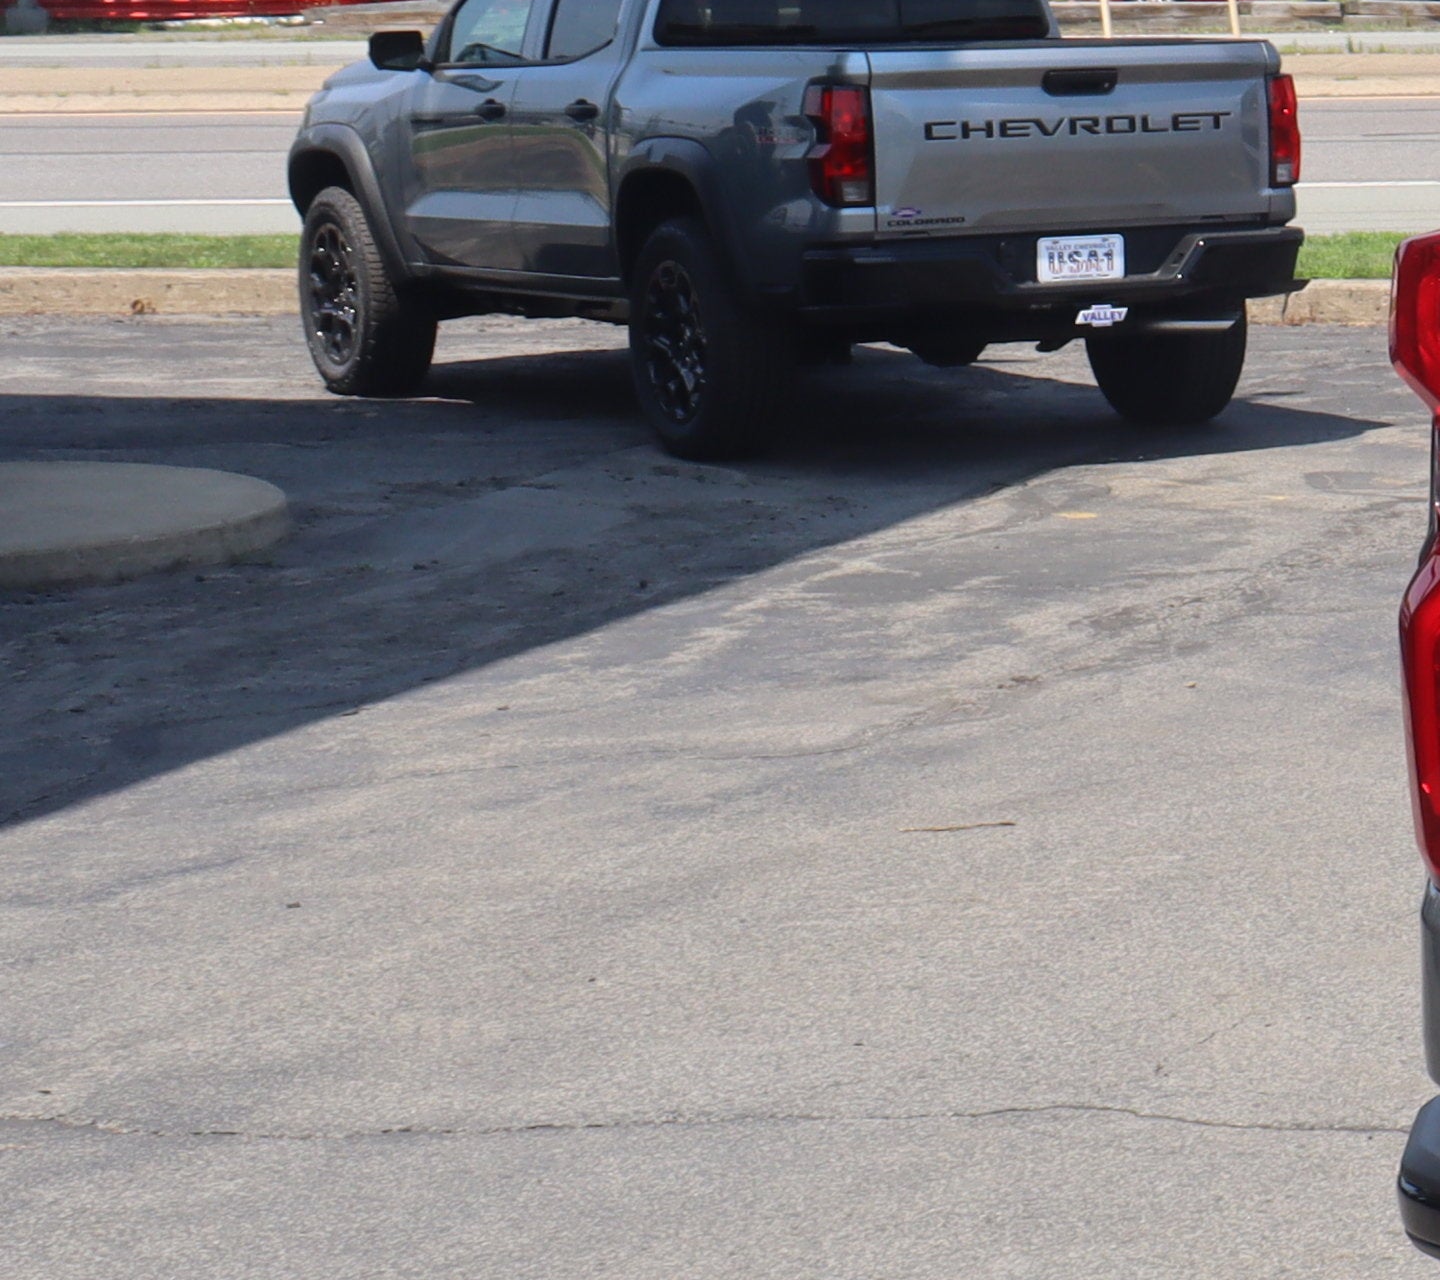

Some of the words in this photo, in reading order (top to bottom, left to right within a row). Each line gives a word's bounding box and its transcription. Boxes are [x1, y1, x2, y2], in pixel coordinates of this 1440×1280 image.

[924, 111, 1232, 141] CHEVROLET
[887, 216, 965, 227] COLORADO
[1082, 310, 1123, 322] VALLEY
